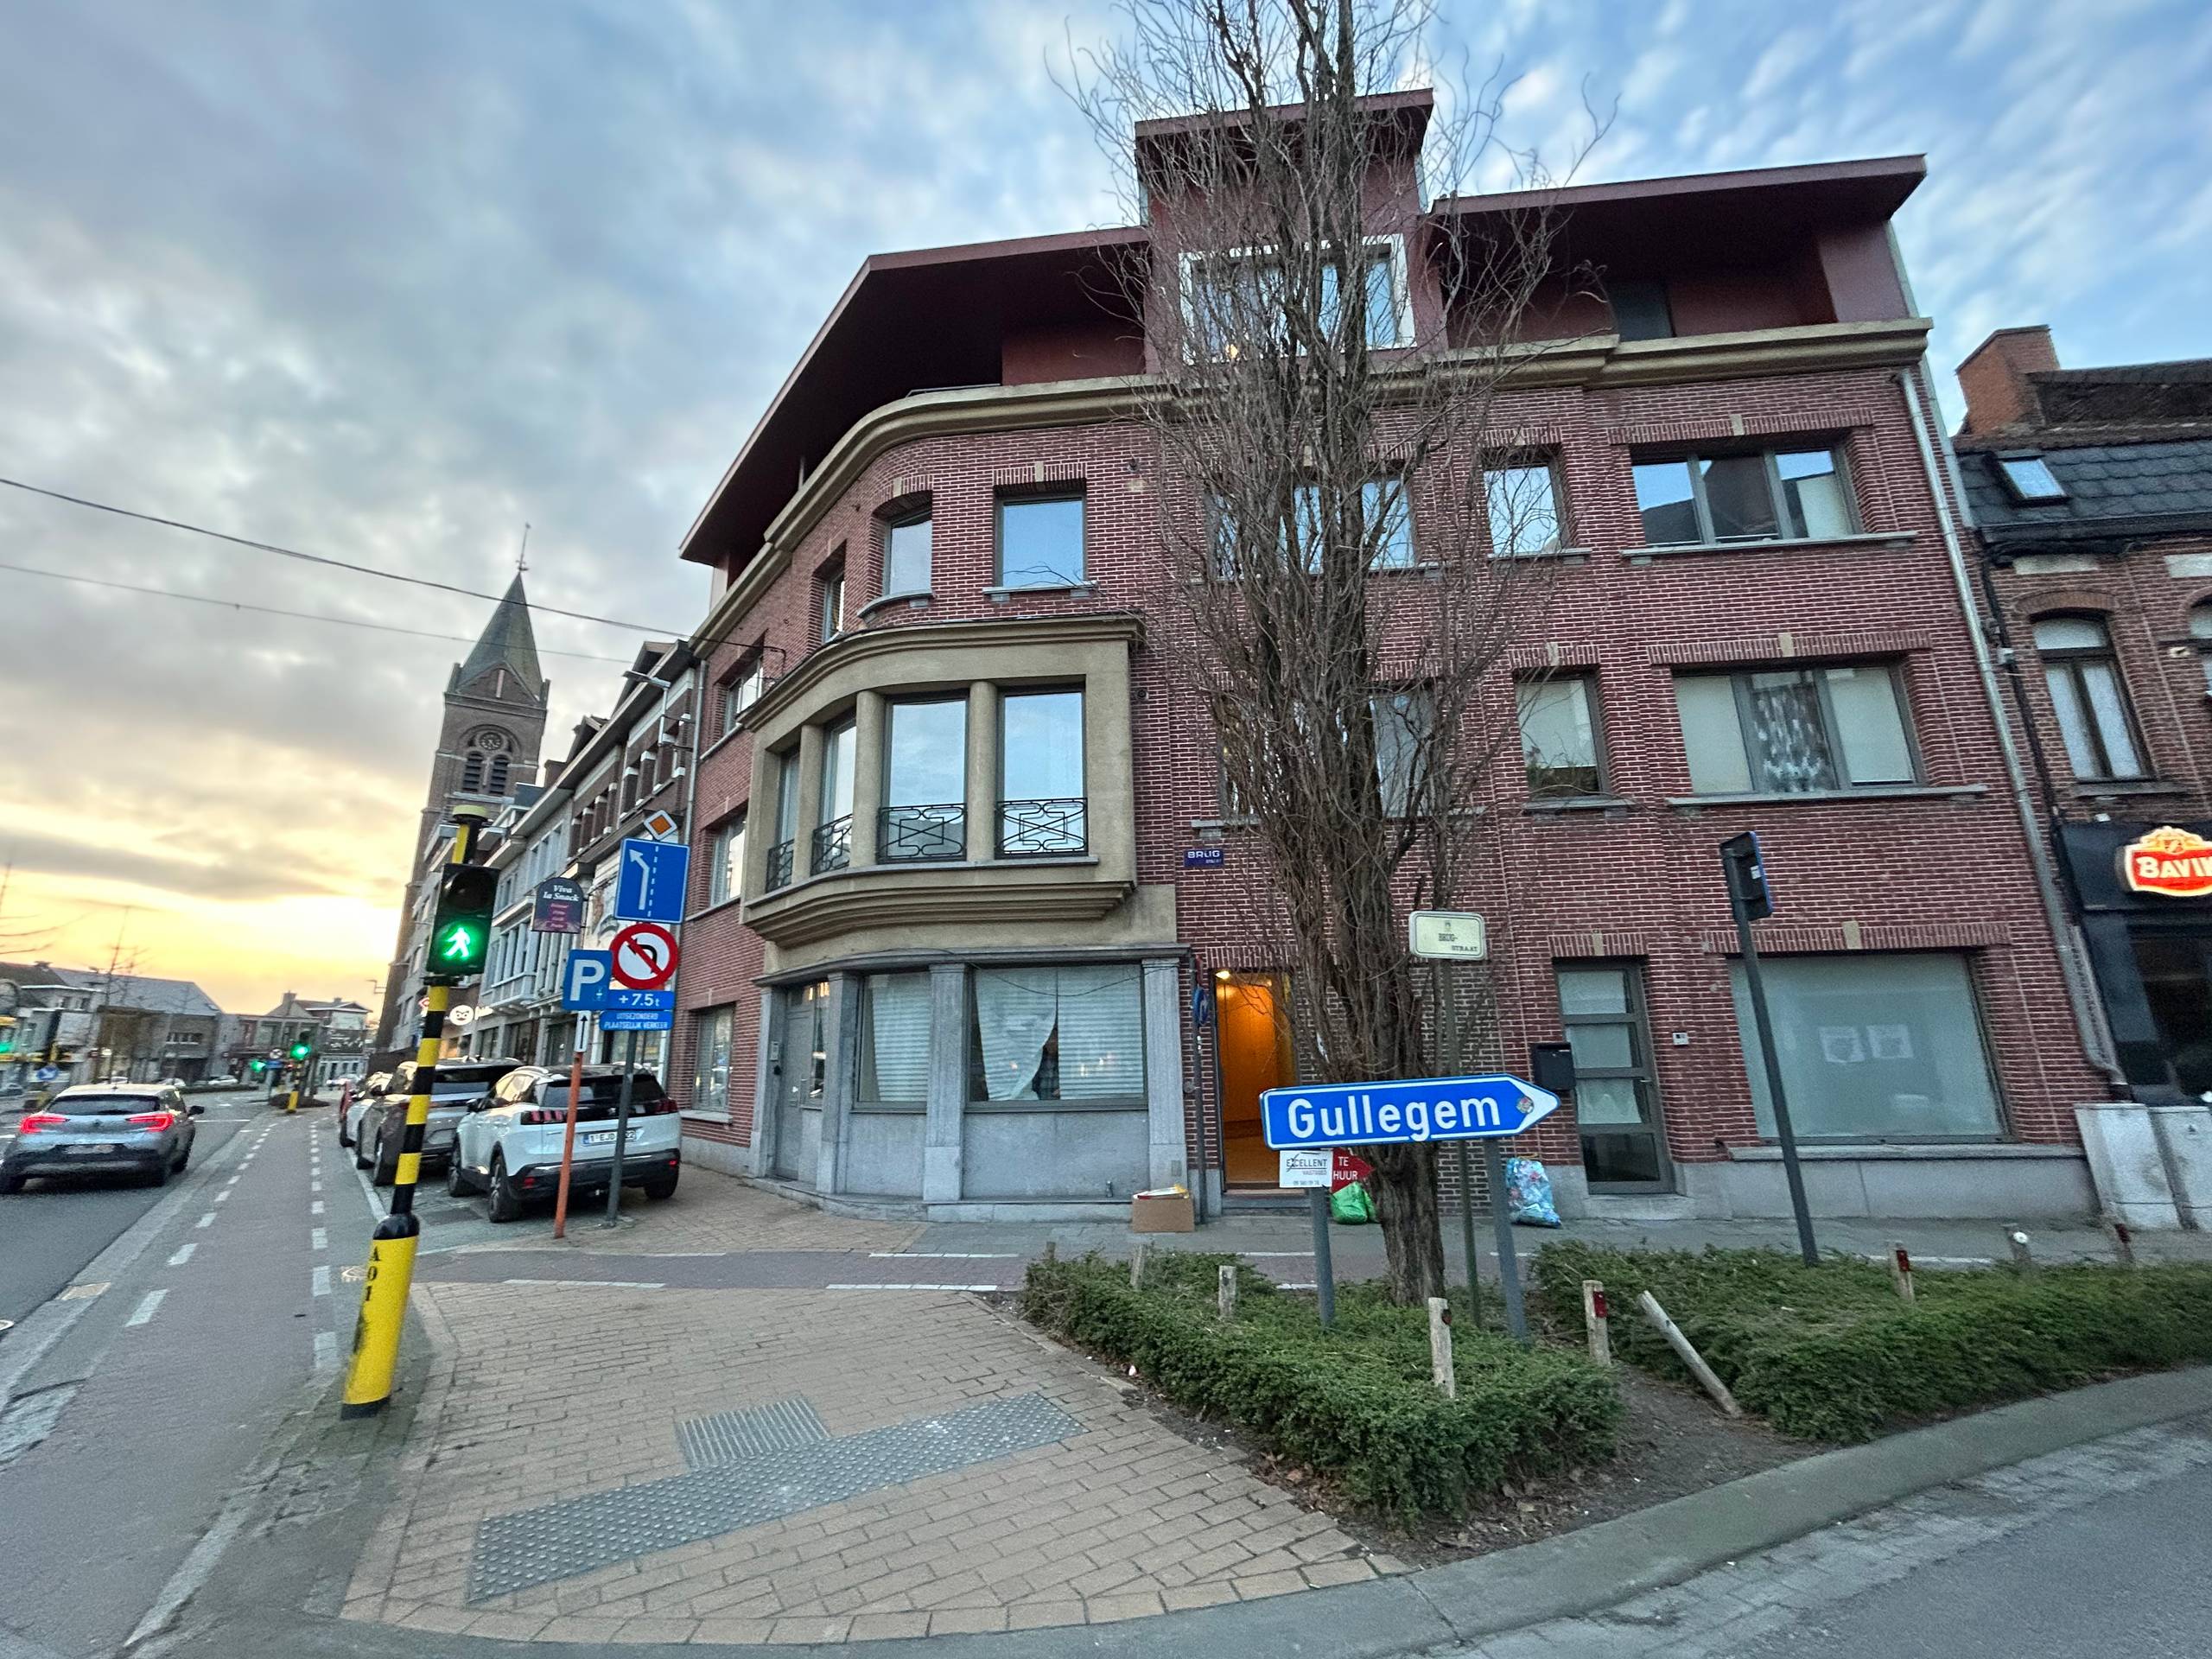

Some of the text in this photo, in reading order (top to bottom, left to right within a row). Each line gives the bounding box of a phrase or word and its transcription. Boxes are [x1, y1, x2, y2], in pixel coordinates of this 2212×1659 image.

[553, 885, 573, 893] Viva
[570, 959, 605, 1001] P
[1287, 1094, 1501, 1142] Gullegem
[1338, 1156, 1350, 1166] TE
[1333, 1170, 1358, 1181] HUUR
